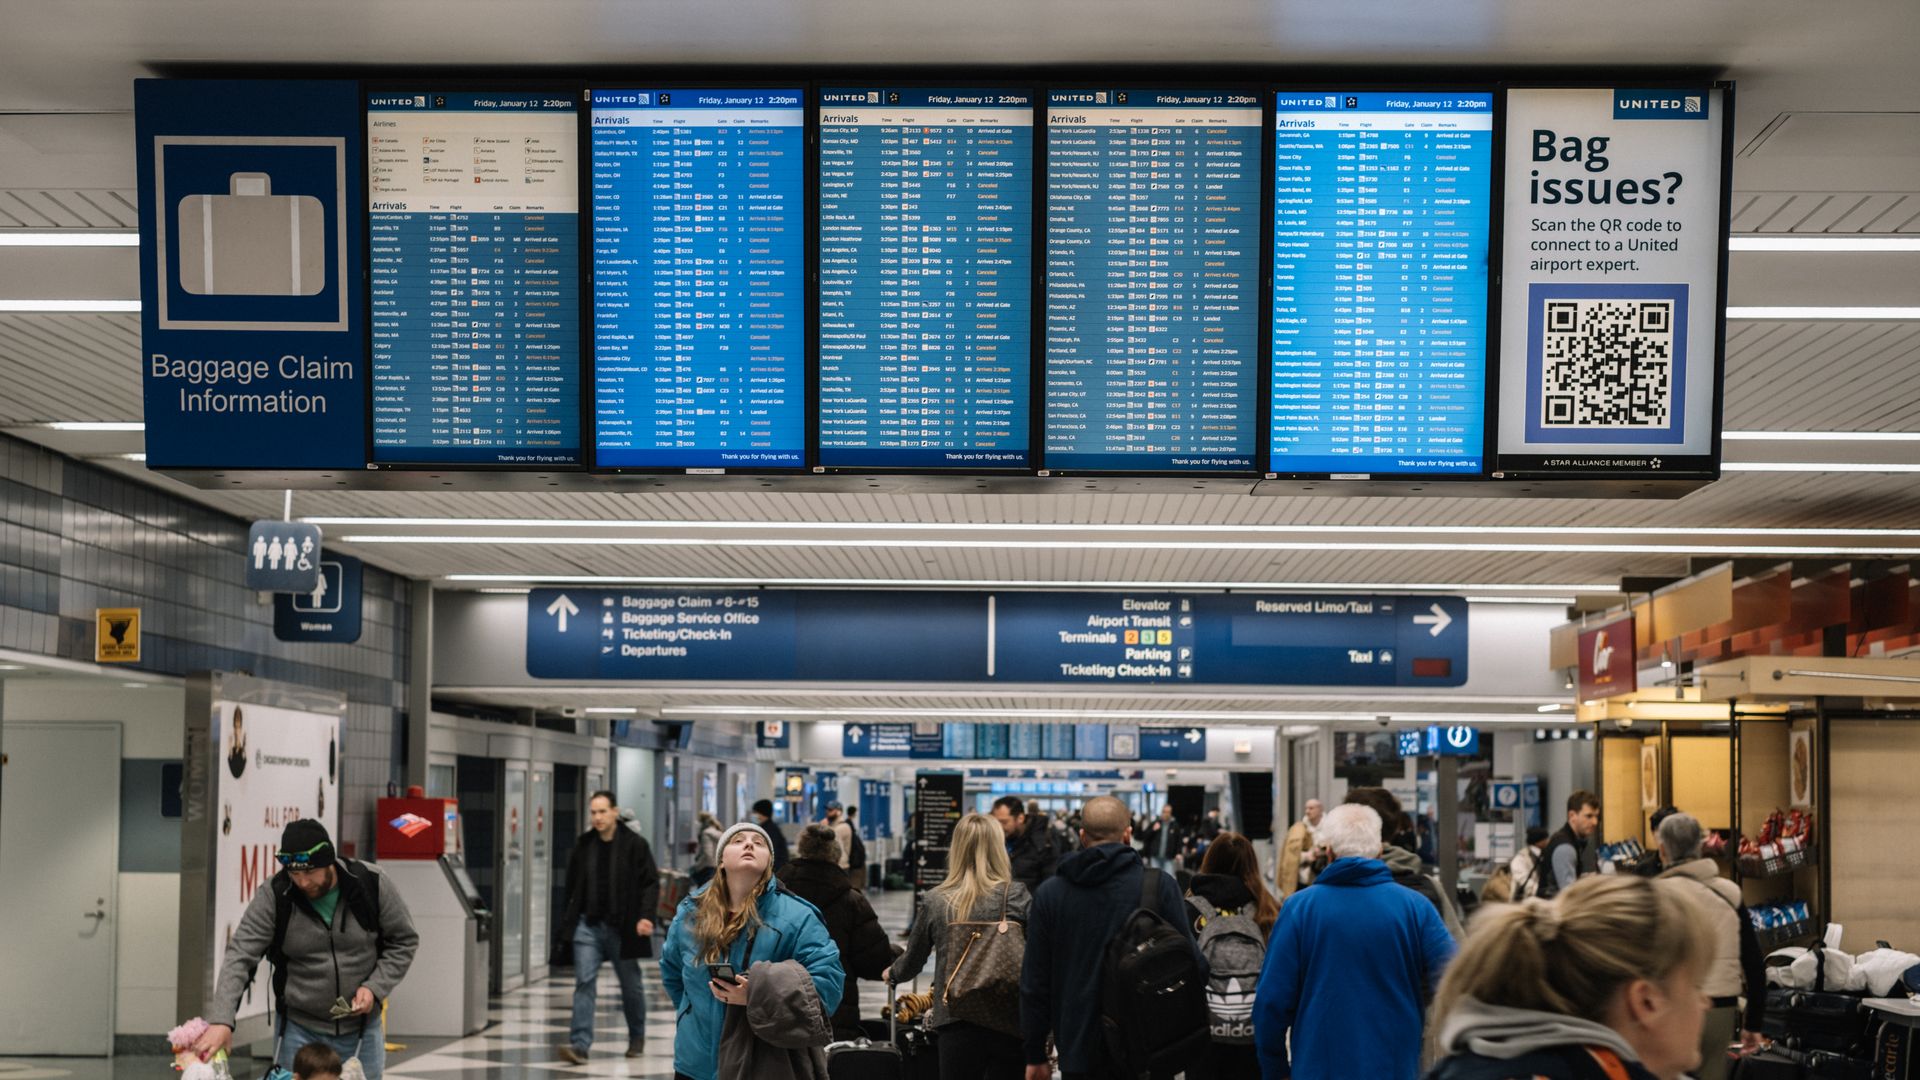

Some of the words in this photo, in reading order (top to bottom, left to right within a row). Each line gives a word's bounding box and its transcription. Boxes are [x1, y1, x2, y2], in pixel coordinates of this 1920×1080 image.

[999, 96, 1027, 104] 2:20pm
[1228, 96, 1256, 104] 2:20pm
[1458, 100, 1486, 108] 2:20pm
[1620, 100, 1680, 108] UNITED
[1051, 115, 1086, 123] Arrivals
[1532, 130, 1610, 173] Bag
[1531, 170, 1682, 204] issues?
[1532, 219, 1566, 231] Scan
[1571, 218, 1595, 231] the
[1600, 219, 1622, 234] QR
[1627, 219, 1662, 231] code
[1667, 220, 1681, 231] to
[1531, 240, 1590, 251] connect
[1595, 240, 1610, 251] to
[1615, 241, 1622, 251] a
[1629, 238, 1678, 251] United
[1531, 258, 1582, 274] airport
[1587, 260, 1638, 274] expert.
[152, 354, 268, 384] Baggage
[279, 356, 352, 379] Claim
[181, 389, 326, 412] Information
[622, 596, 675, 609] Baggage
[677, 596, 712, 607] Claim
[1123, 599, 1170, 610] Elevator
[1256, 601, 1312, 612] Reserved
[1315, 602, 1372, 613] Limo/Taxi
[622, 613, 675, 625] Baggage
[677, 612, 721, 624] Service
[724, 613, 759, 624] Office
[1087, 615, 1128, 628] Airport
[1130, 616, 1171, 627] Transit
[301, 623, 332, 631] Women
[622, 628, 732, 641] Ticketing/Check-In
[1059, 631, 1117, 643] Terminals
[1128, 632, 1135, 642] 2
[1145, 632, 1151, 642] 3
[1161, 632, 1168, 642] 5
[622, 645, 687, 657] Departures
[1126, 648, 1171, 662] Parking
[1348, 650, 1372, 663] Taxi
[1061, 664, 1115, 678] Ticketing
[1118, 664, 1171, 676] Check-In
[265, 806, 279, 828] ALL
